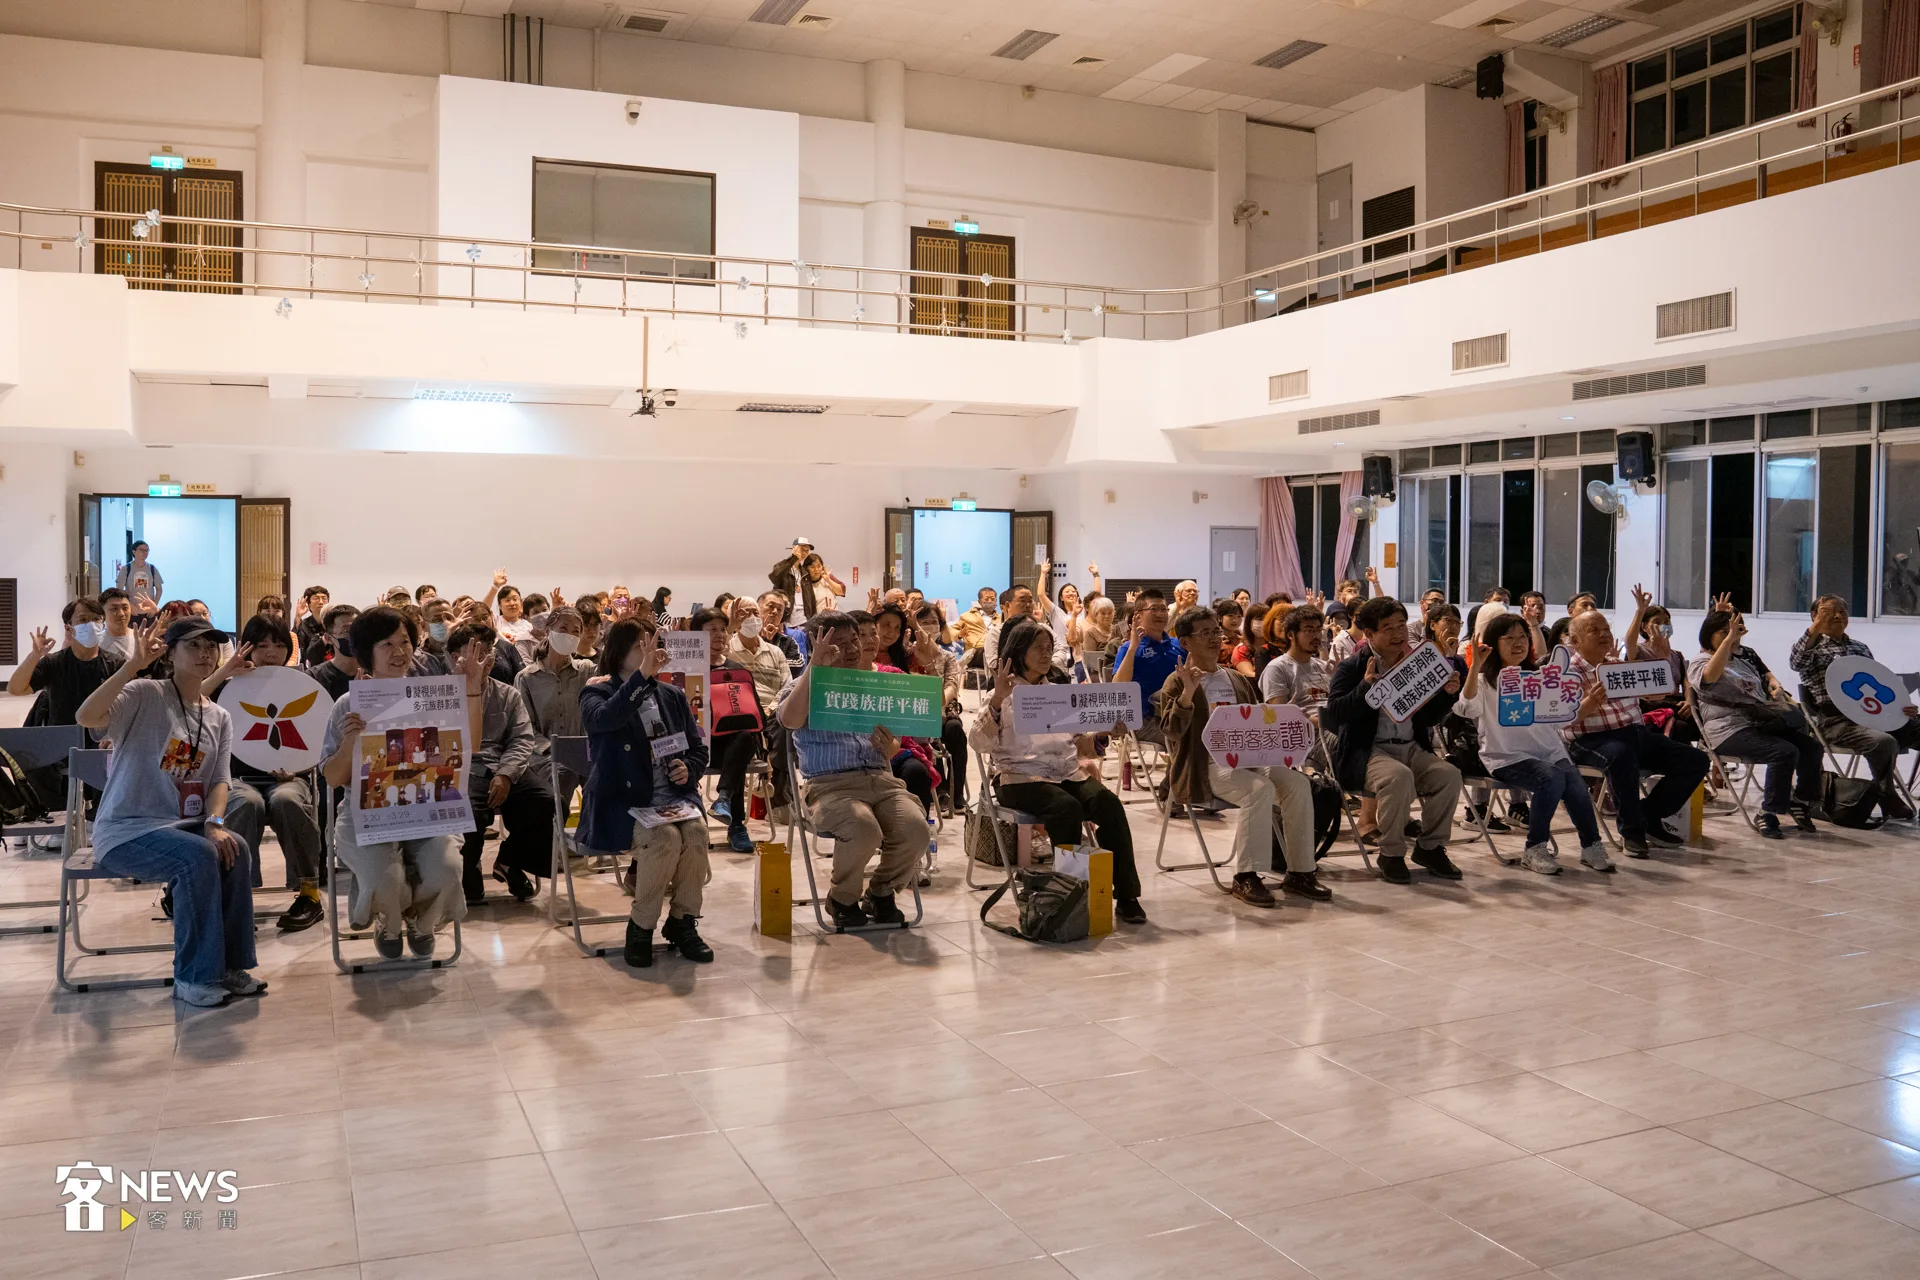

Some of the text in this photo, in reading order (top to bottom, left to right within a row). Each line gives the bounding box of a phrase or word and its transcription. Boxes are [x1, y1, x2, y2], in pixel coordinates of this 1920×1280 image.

[1390, 647, 1438, 692] 國際消除
[1605, 667, 1668, 691] 族群平權
[1392, 663, 1449, 716] 種族歧視日
[1501, 664, 1581, 703] 臺南客家
[413, 698, 461, 712] 多元族群影展
[823, 690, 930, 715] 實踐族群平權
[1079, 709, 1135, 725] 多元族群影展
